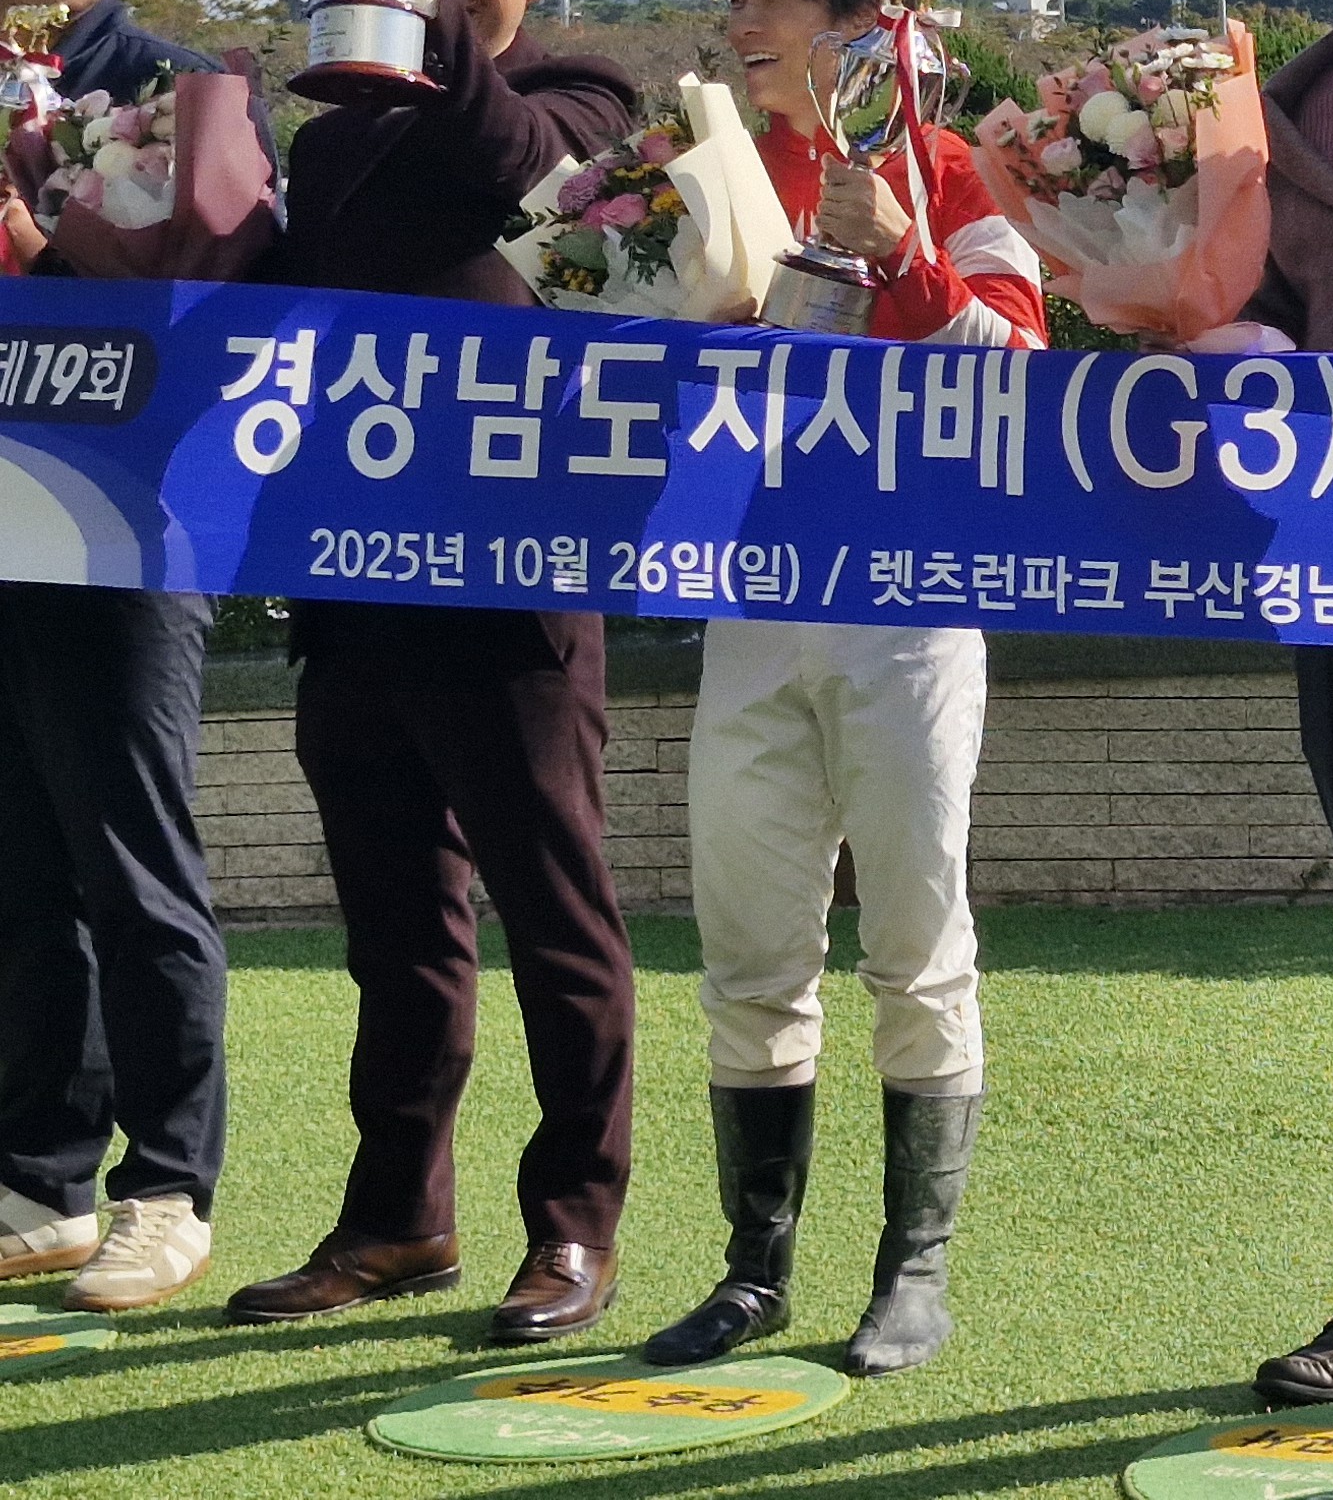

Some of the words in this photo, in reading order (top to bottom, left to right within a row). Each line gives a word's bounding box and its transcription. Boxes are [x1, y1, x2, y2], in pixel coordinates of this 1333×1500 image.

[310, 528, 466, 587] 2025년
[488, 536, 590, 593] 10월
[609, 540, 802, 605] 26일(일)
[868, 549, 1124, 613] 렛츠런파크
